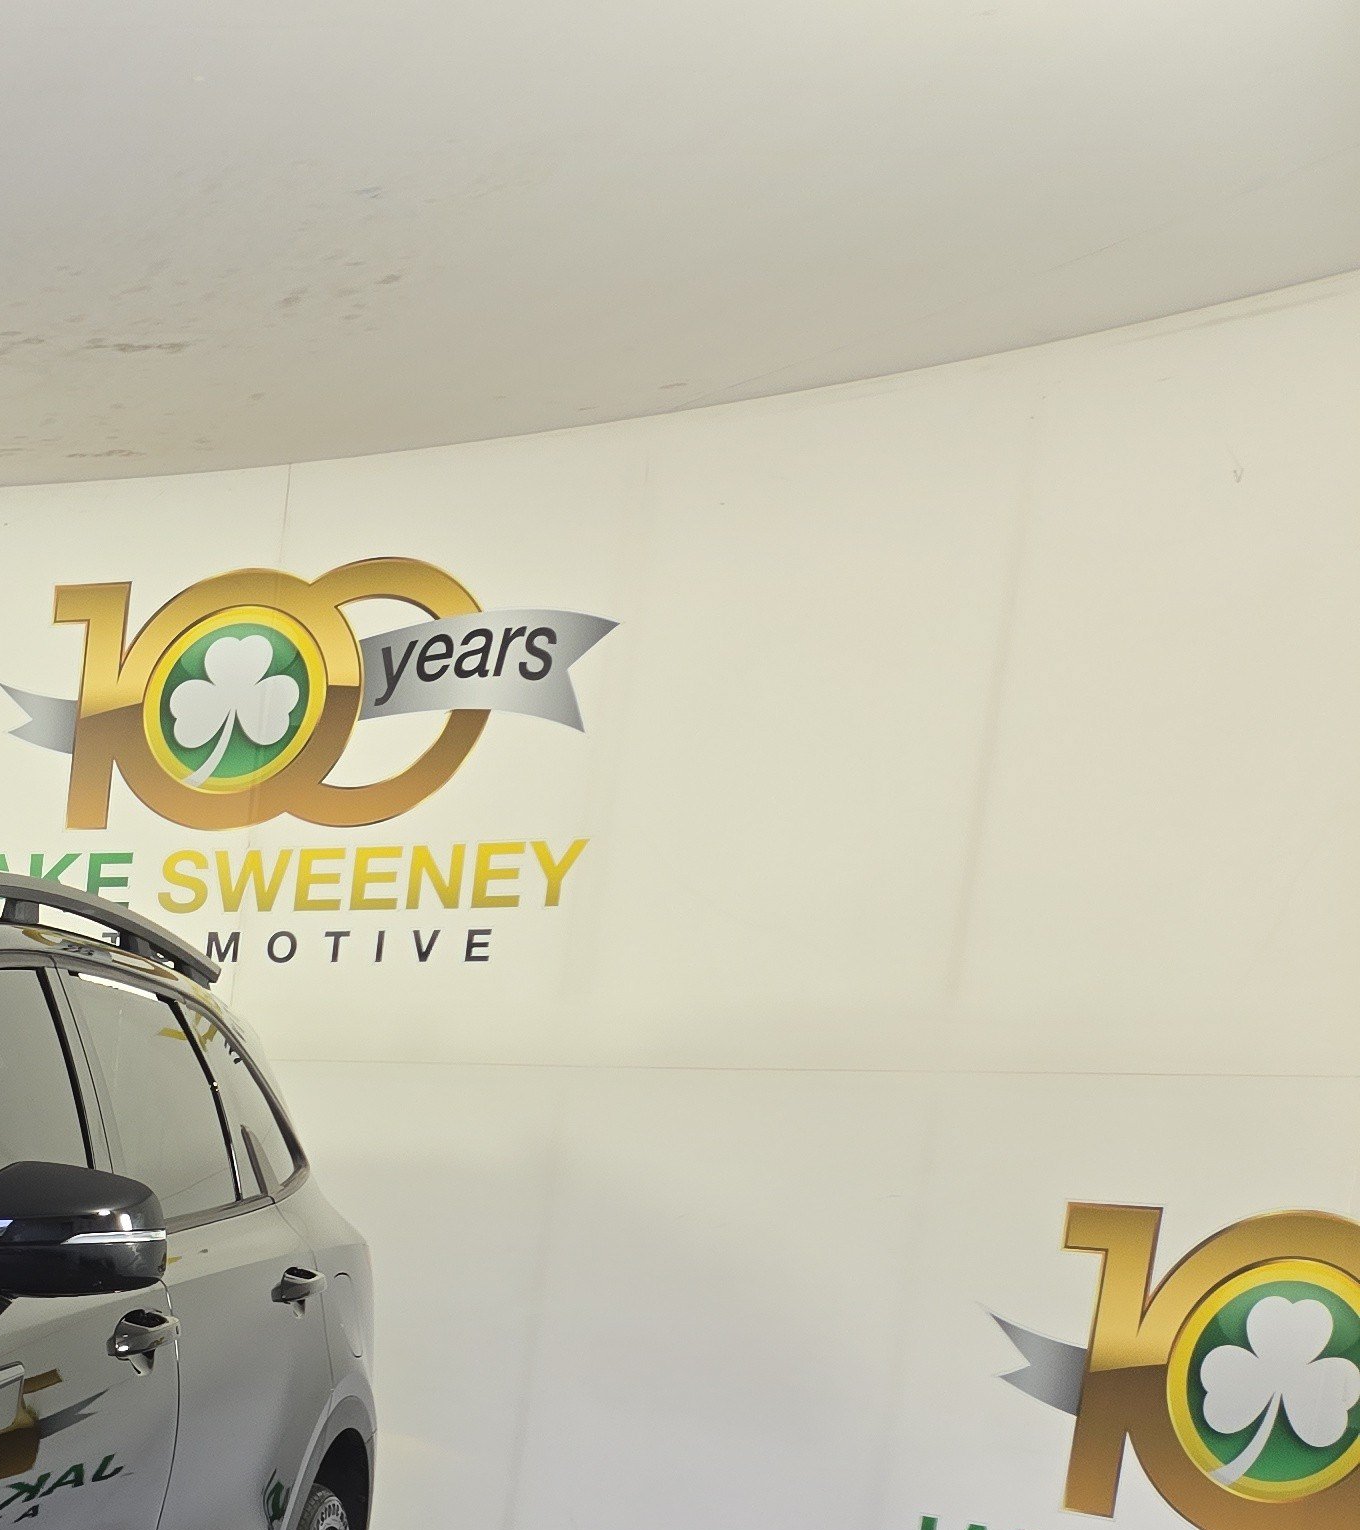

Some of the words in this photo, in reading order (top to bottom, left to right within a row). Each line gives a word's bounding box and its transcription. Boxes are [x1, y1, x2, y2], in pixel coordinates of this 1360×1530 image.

[373, 622, 559, 707] years
[156, 838, 591, 915] SWEENEY
[206, 928, 496, 964] MOTIVE
